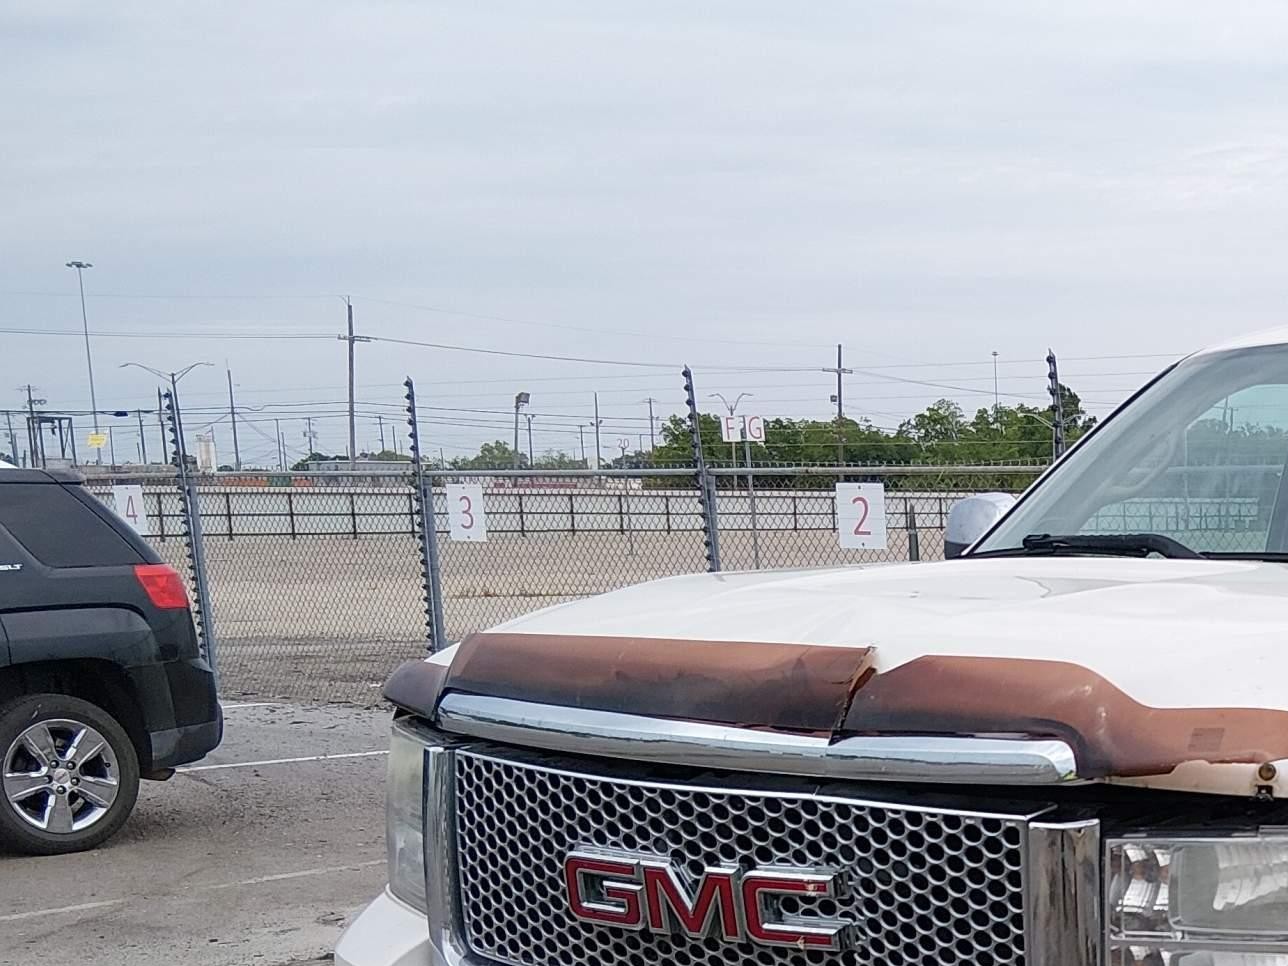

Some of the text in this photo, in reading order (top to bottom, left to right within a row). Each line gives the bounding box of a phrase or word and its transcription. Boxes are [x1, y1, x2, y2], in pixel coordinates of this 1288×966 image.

[725, 416, 736, 441] F
[748, 415, 762, 440] G
[126, 495, 139, 525] 4
[459, 495, 474, 530] 3
[852, 496, 872, 536] 2
[564, 847, 850, 952] GMC
